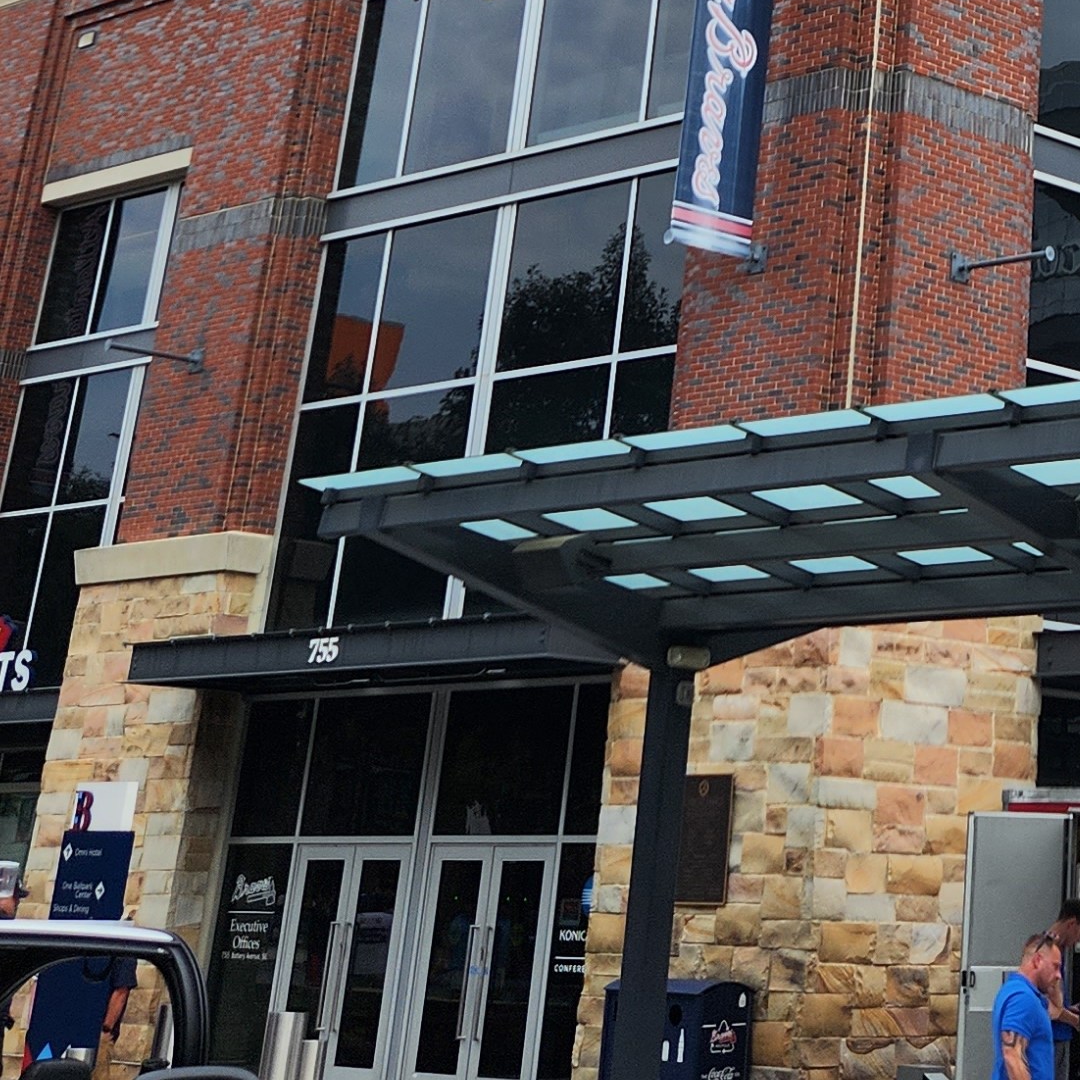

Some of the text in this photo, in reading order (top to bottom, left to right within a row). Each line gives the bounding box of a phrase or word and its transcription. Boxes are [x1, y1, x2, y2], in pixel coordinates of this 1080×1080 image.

[691, 1, 758, 209] Braves
[308, 636, 340, 663] 755
[230, 918, 268, 932] Executive
[232, 935, 260, 949] Offices
